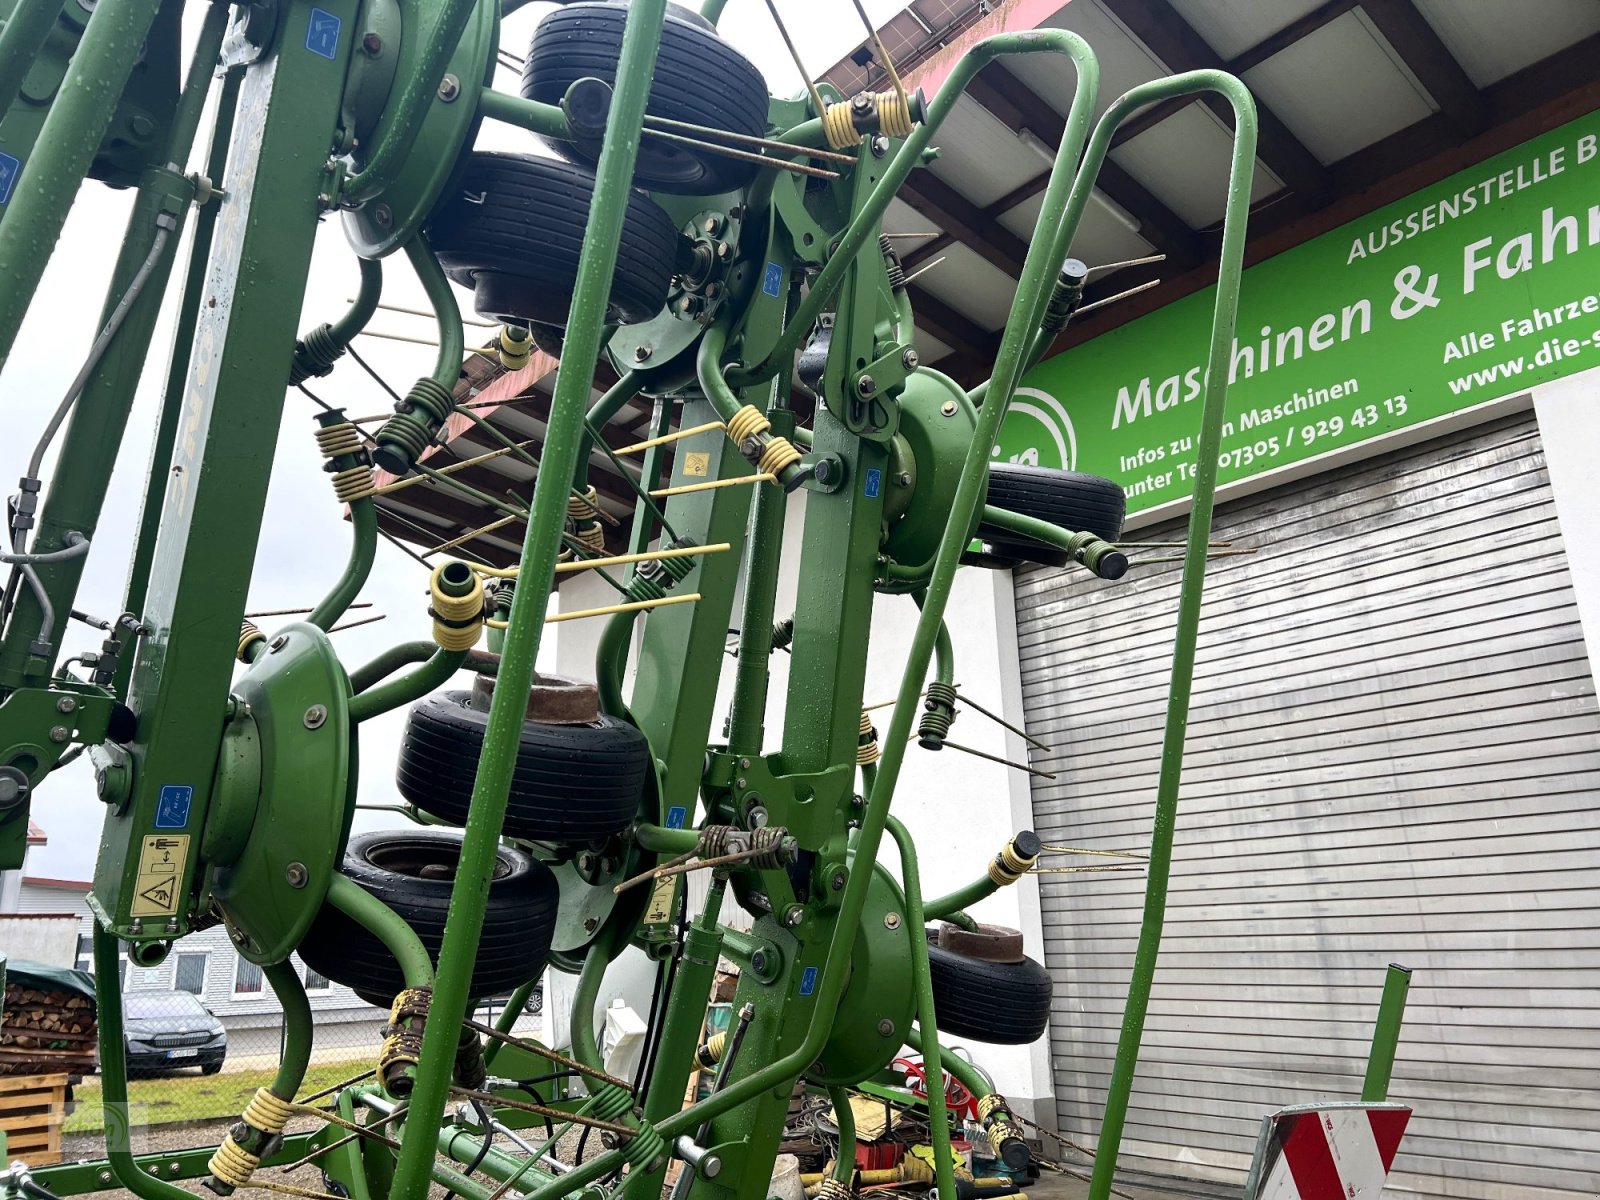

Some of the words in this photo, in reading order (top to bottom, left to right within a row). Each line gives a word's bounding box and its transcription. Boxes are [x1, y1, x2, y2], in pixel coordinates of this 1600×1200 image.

[1347, 147, 1565, 265] AUSSENSTELLE
[1111, 299, 1371, 430] Mashinen
[1389, 265, 1441, 321] &
[1443, 332, 1495, 364] Alle
[1120, 447, 1165, 472] Infos
[1170, 437, 1192, 455] zu
[1240, 378, 1359, 431] Maschinen
[1123, 471, 1173, 499] unter
[1176, 462, 1198, 480] Te
[1218, 436, 1279, 468] 07305
[1301, 415, 1344, 446] 929
[1351, 404, 1379, 428] 43
[1383, 395, 1408, 416] 13
